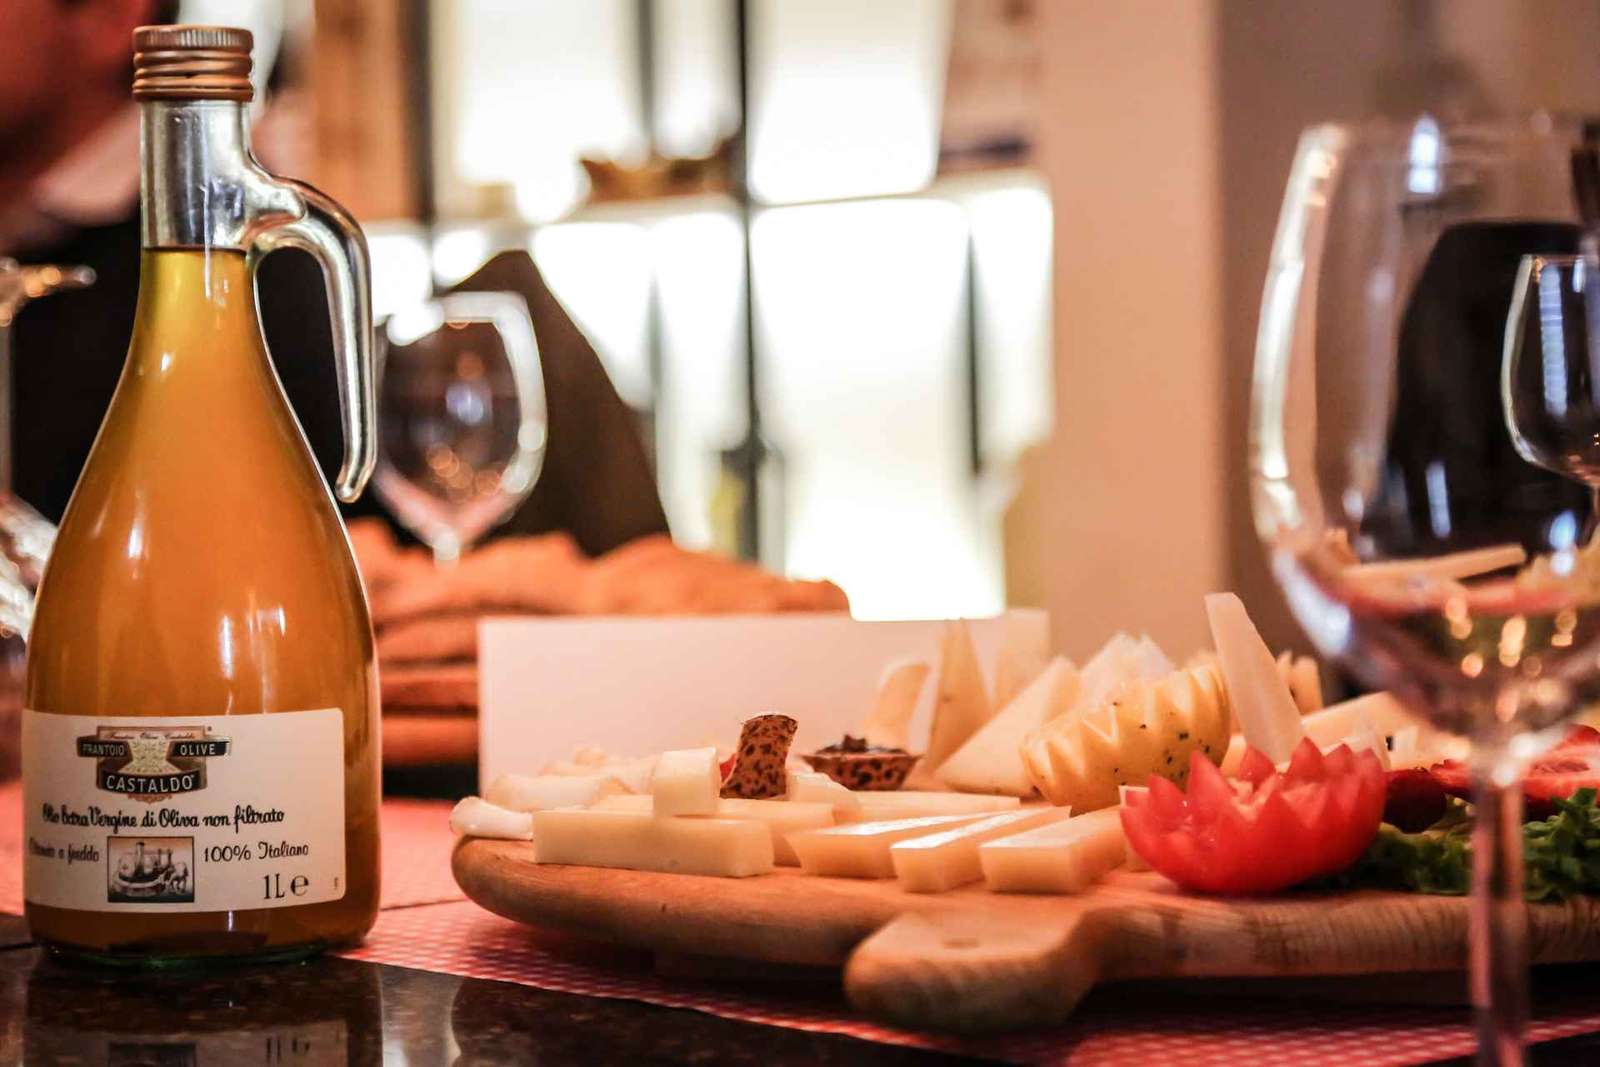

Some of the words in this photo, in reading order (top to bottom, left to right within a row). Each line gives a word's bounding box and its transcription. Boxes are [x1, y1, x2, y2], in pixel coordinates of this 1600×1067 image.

[82, 743, 125, 756] FRANTOIO
[180, 743, 216, 756] OLIVE
[106, 774, 193, 793] CASTALDO
[88, 806, 138, 834] Vergine
[141, 811, 157, 827] di
[159, 808, 200, 828] Oliva
[202, 815, 231, 827] non
[233, 805, 285, 834] filtrato
[204, 845, 251, 862] 100%
[258, 841, 309, 860] Italiano
[263, 873, 285, 900] 1L
